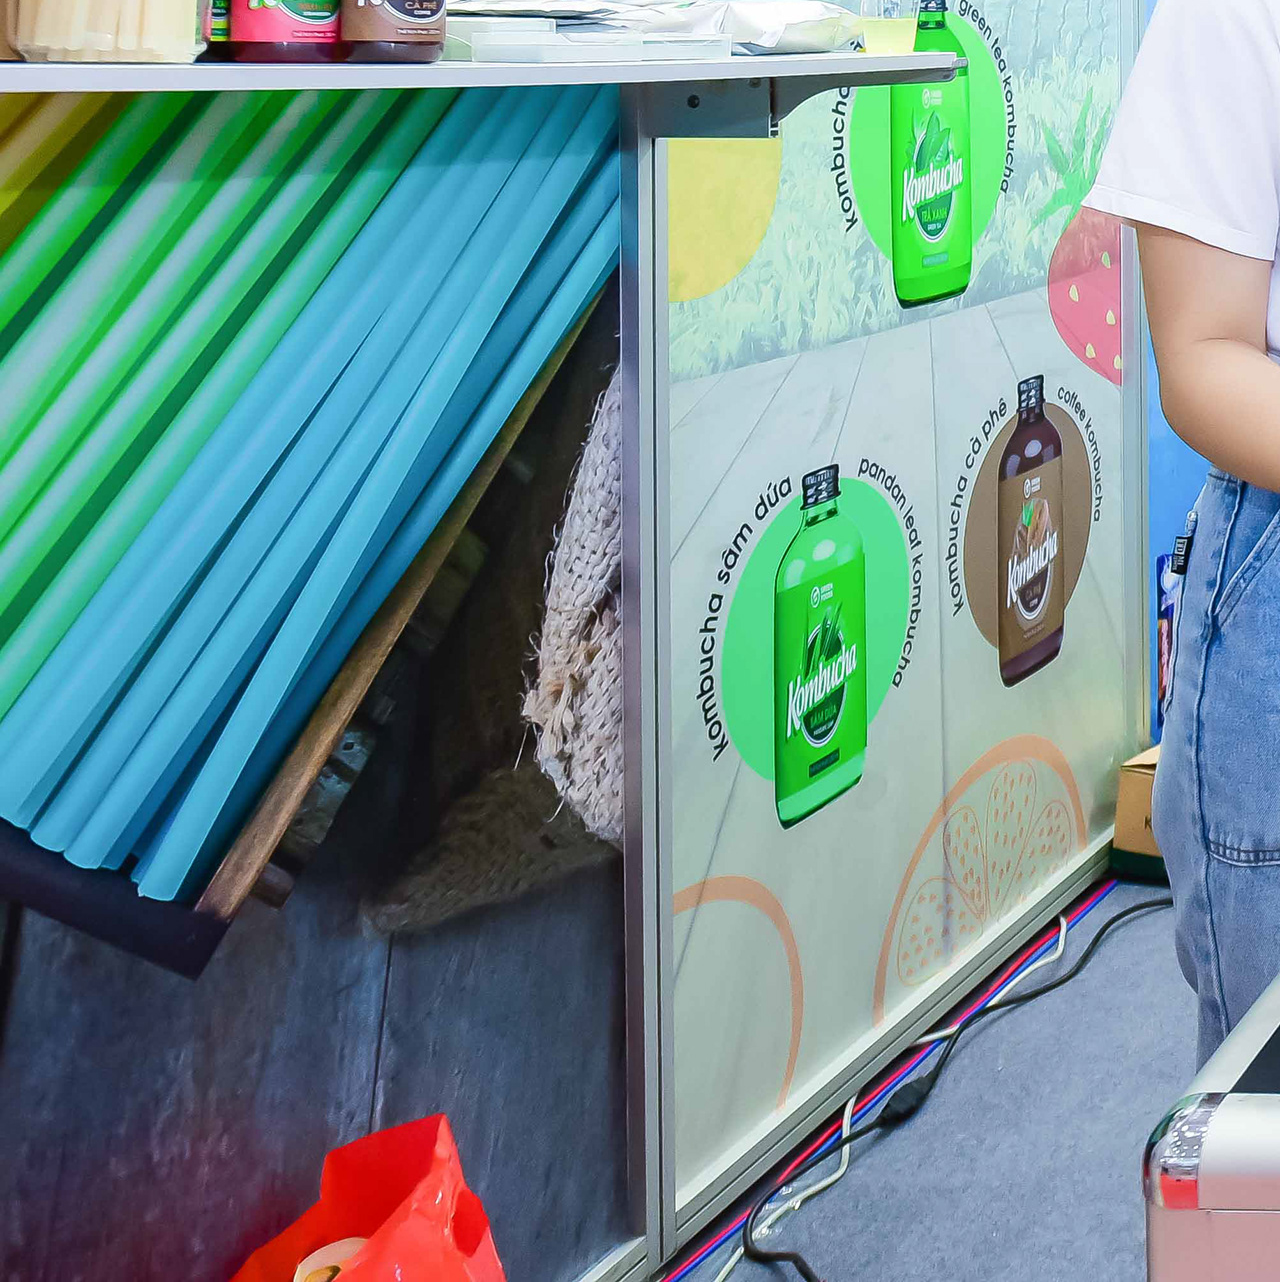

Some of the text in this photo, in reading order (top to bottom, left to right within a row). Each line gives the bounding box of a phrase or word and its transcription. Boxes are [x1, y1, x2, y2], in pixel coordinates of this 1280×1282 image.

[830, 86, 858, 233] kombucha
[902, 153, 963, 222] Kombucha
[990, 36, 1007, 75] tea
[999, 74, 1017, 194] kombucha
[945, 398, 1008, 617] kombucha cà phê
[1057, 385, 1102, 523] coffee kombucha
[696, 475, 794, 761] kombucha sâm dứa
[857, 457, 923, 690] pandan leaf kombucha
[1006, 530, 1058, 609] Kombucha
[786, 643, 857, 738] Kombucha
